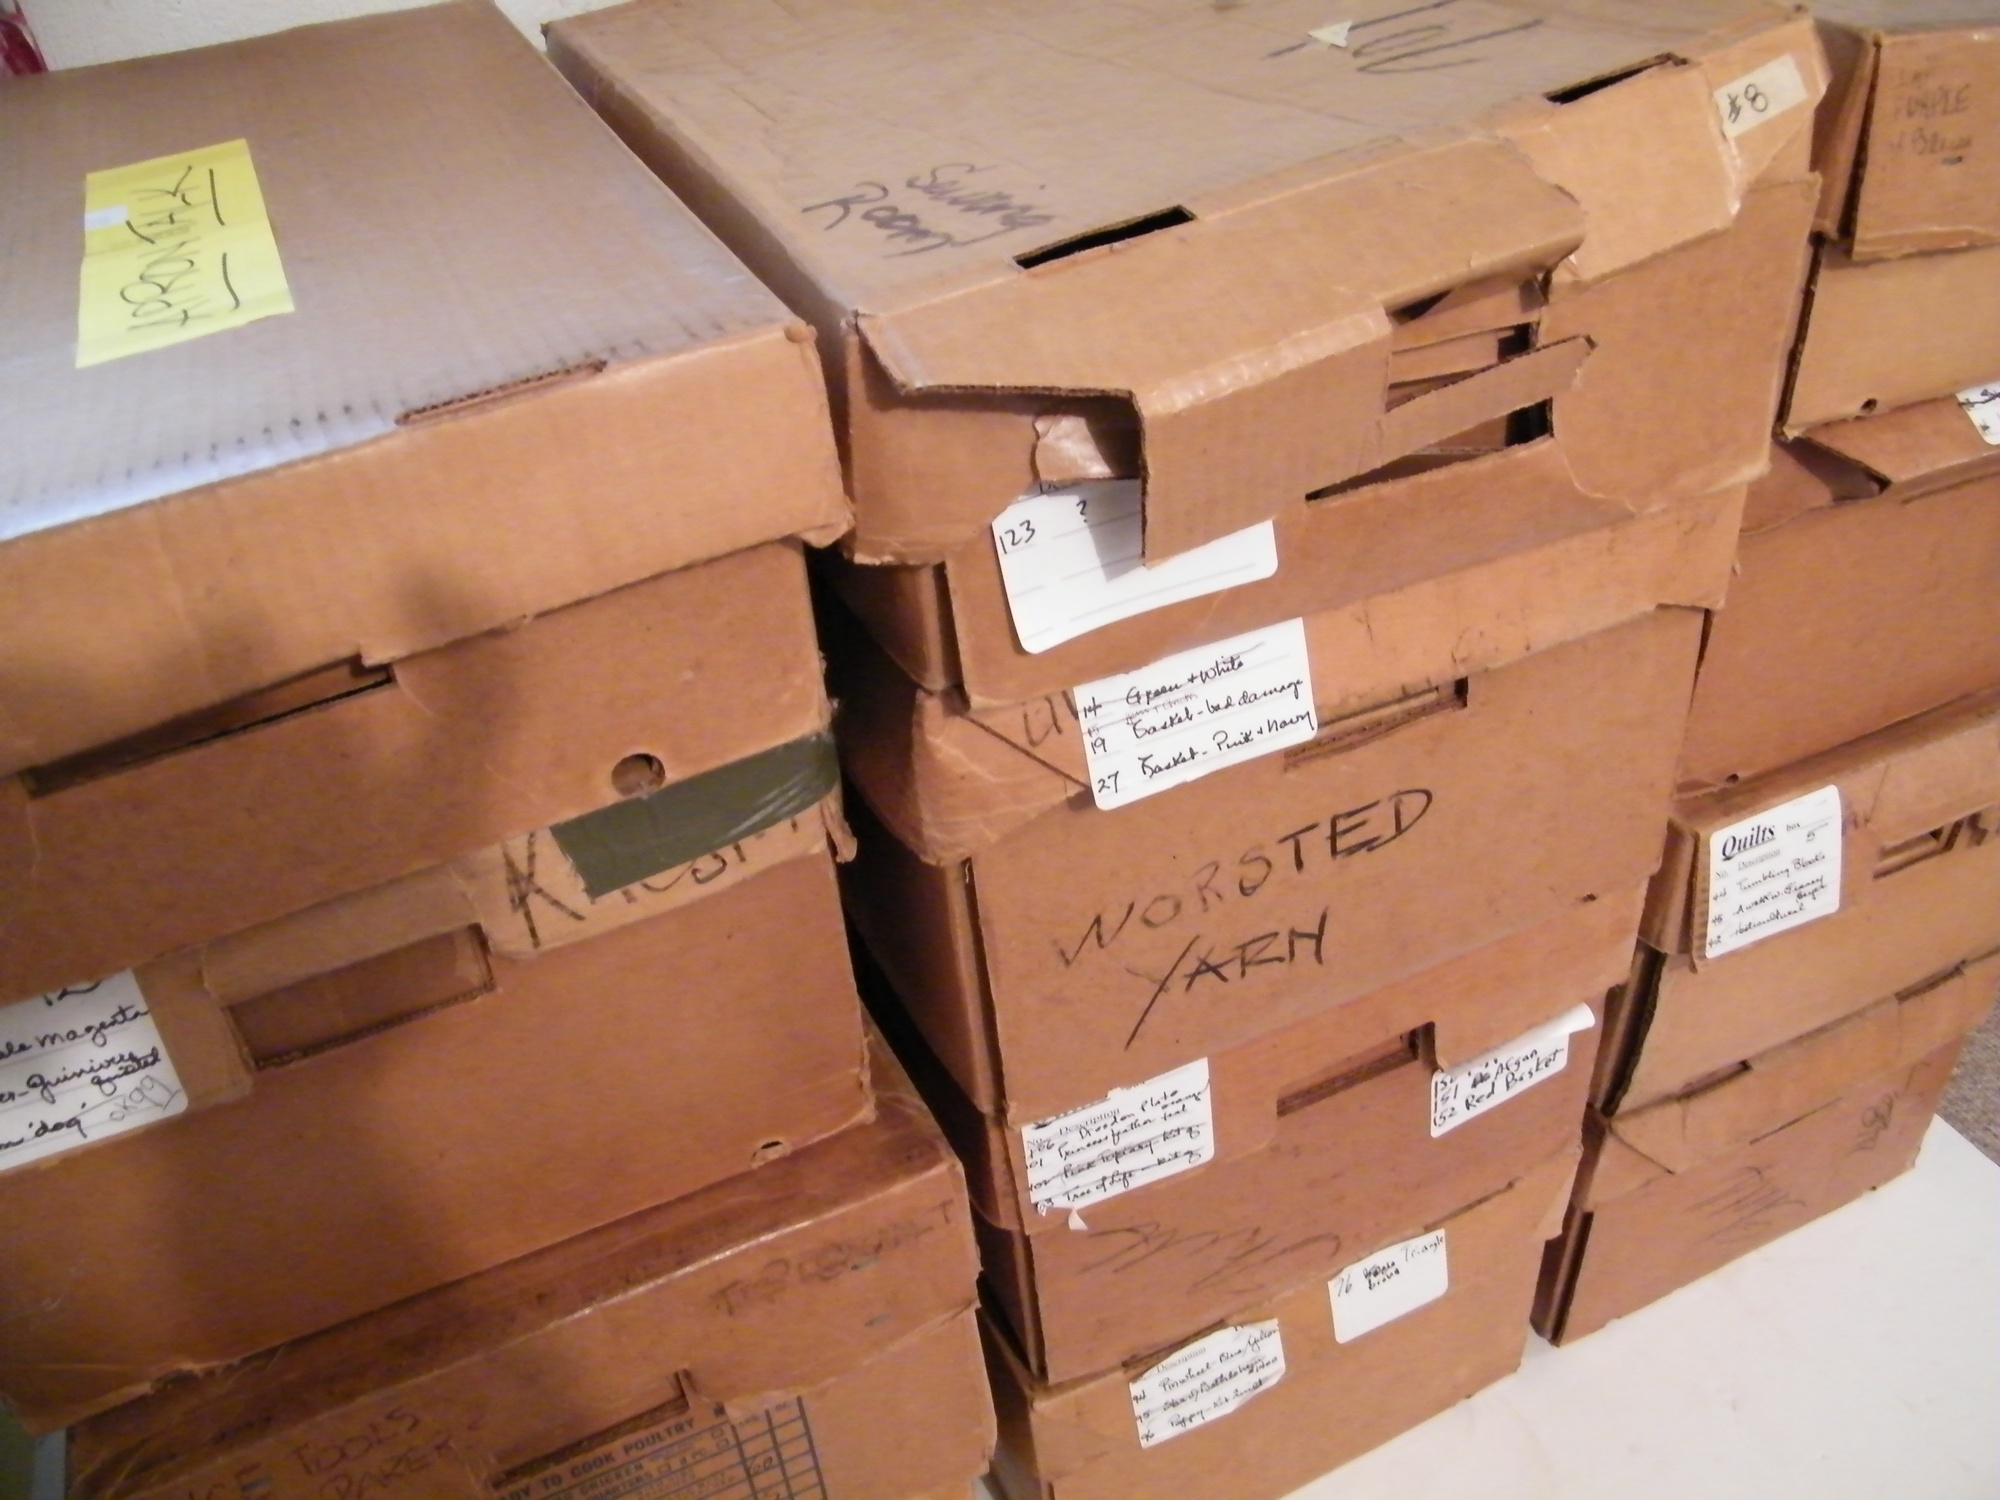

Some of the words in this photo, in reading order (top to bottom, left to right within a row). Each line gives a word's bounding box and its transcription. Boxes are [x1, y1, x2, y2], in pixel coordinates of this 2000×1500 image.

[999, 519, 1036, 555] 123
[1090, 737, 1108, 755] 19
[1097, 771, 1120, 793] 27
[1721, 824, 1777, 861] Quilts
[1051, 788, 1433, 967] WORSTED
[1125, 904, 1330, 1052] YARN
[622, 1417, 696, 1456] POULTRY
